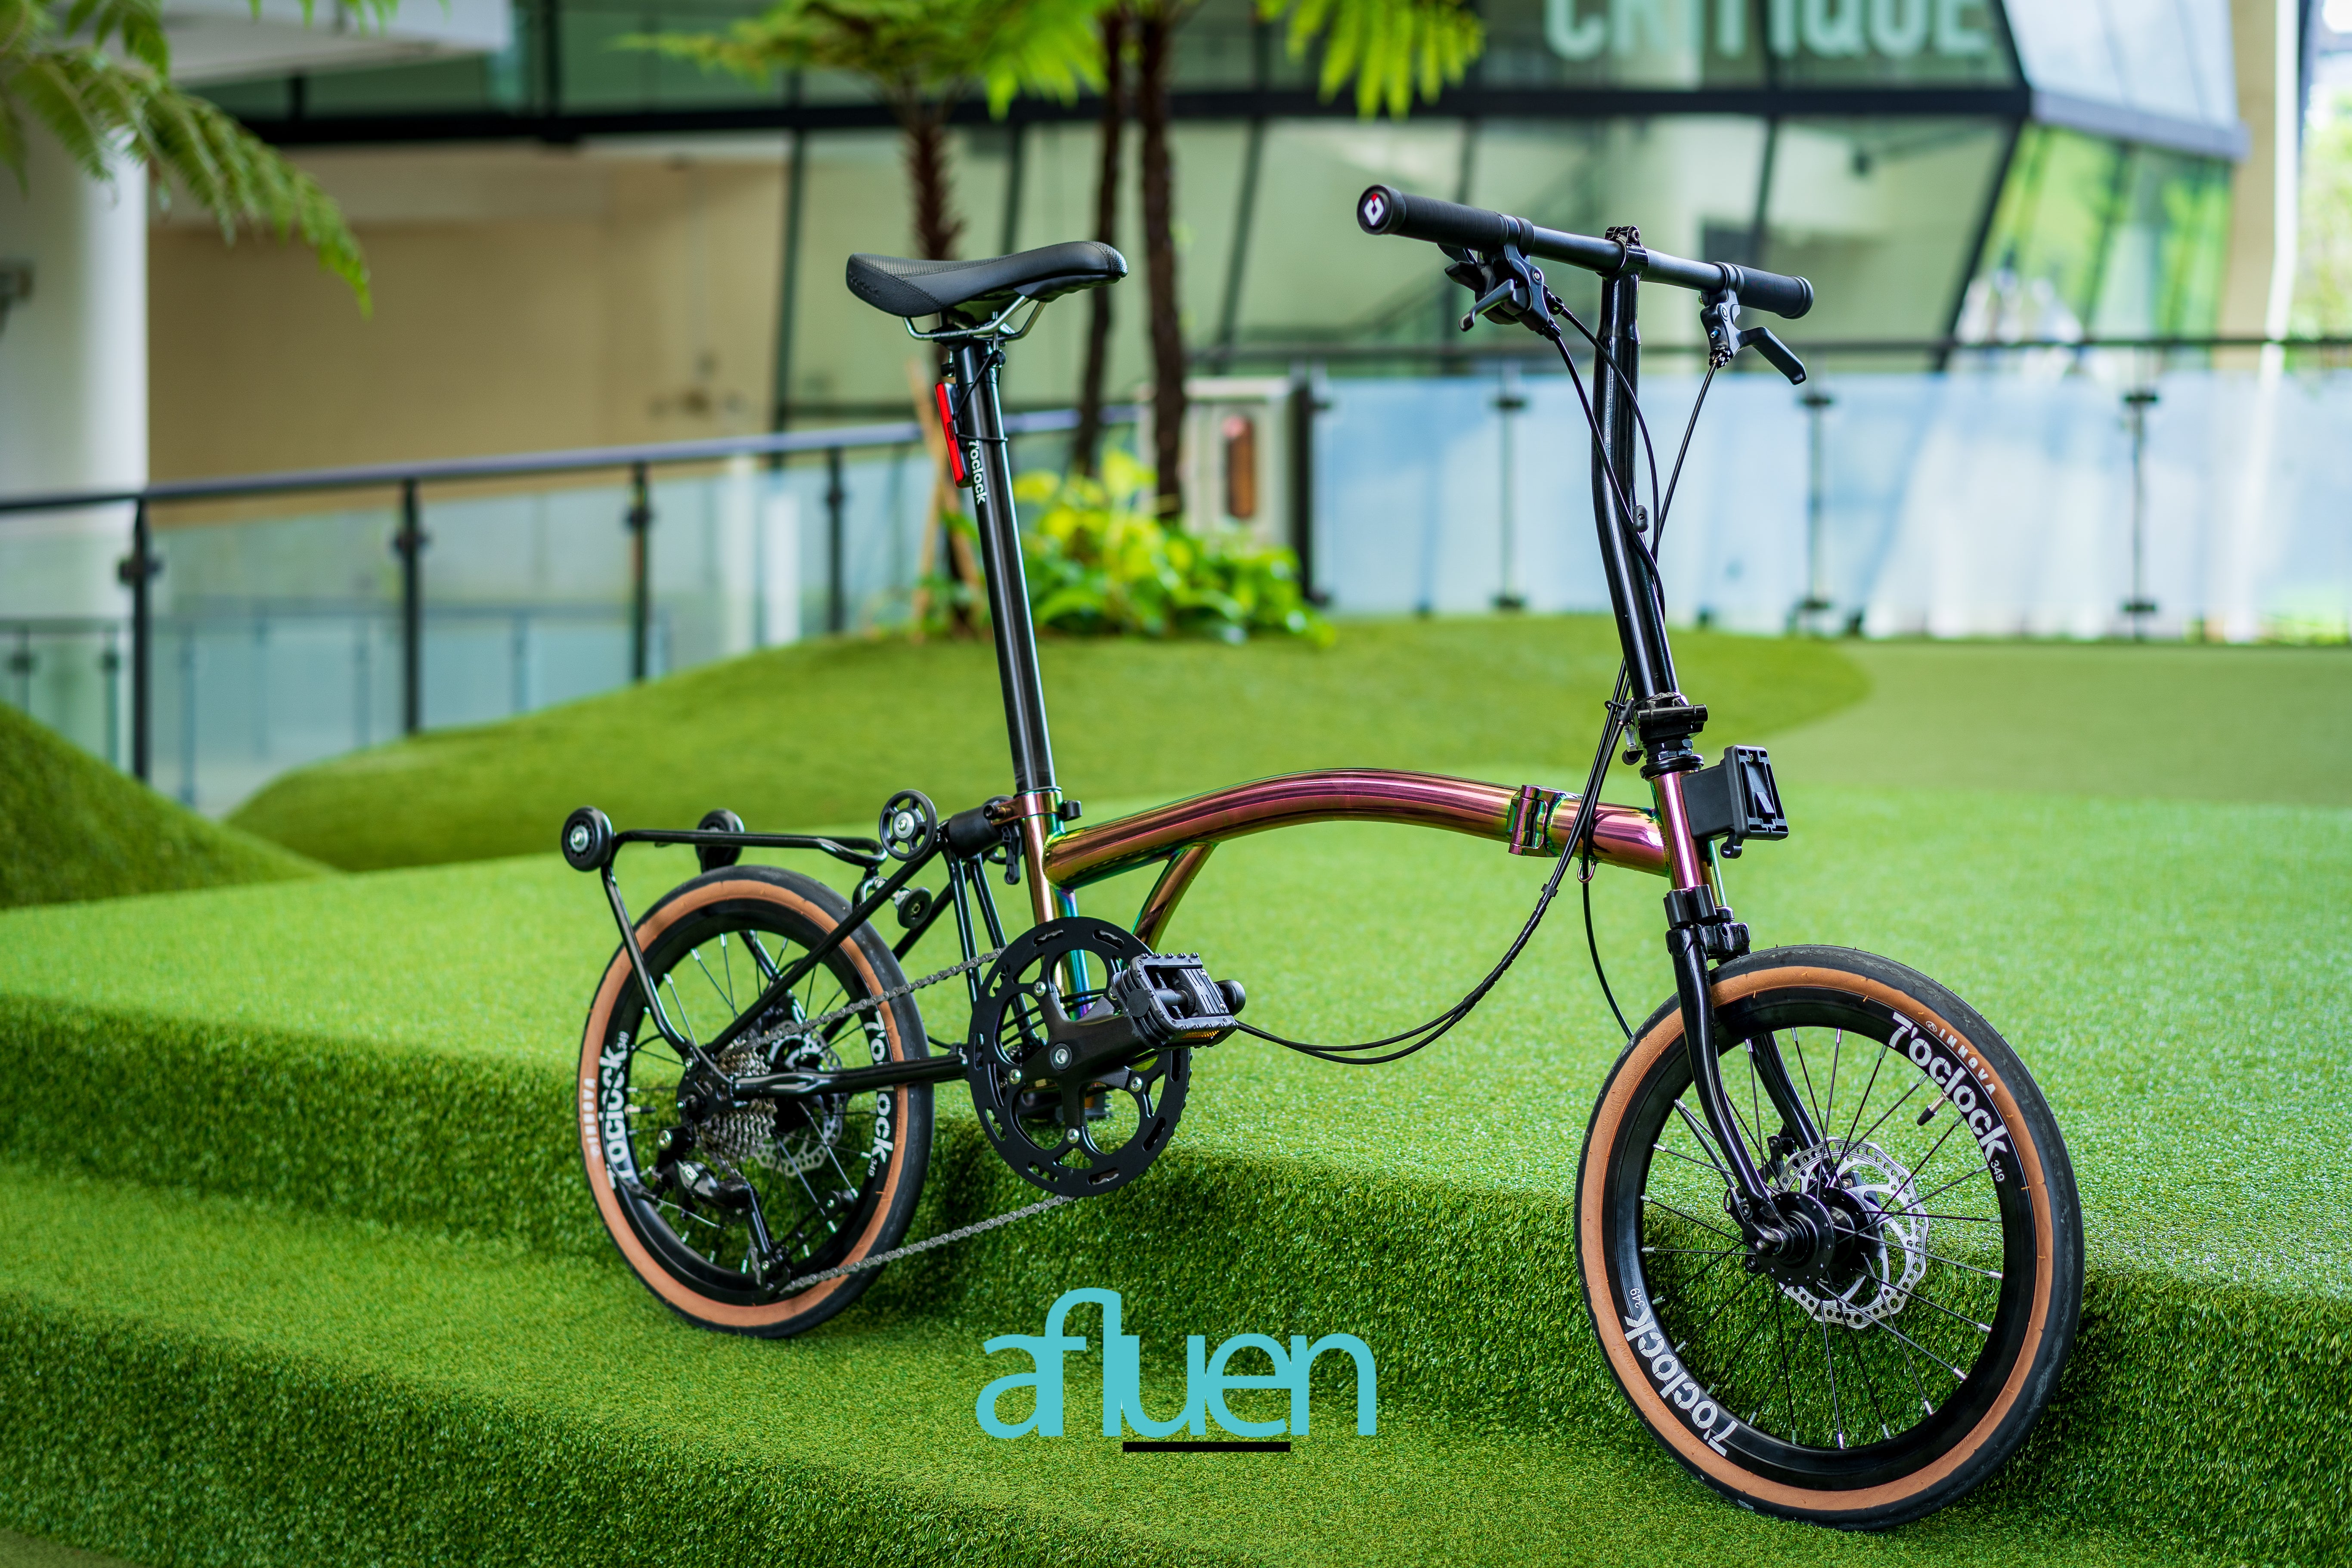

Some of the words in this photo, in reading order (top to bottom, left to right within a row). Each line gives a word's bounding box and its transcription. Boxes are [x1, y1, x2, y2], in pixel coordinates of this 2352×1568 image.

[1938, 1028, 1997, 1095] INNOVA
[1888, 1011, 2008, 1162] 7'oclock
[867, 1157, 877, 1178] 349
[1990, 1160, 2005, 1183] 349
[1630, 1287, 1645, 1309] 349
[1624, 1305, 1738, 1456] 7'oclock
